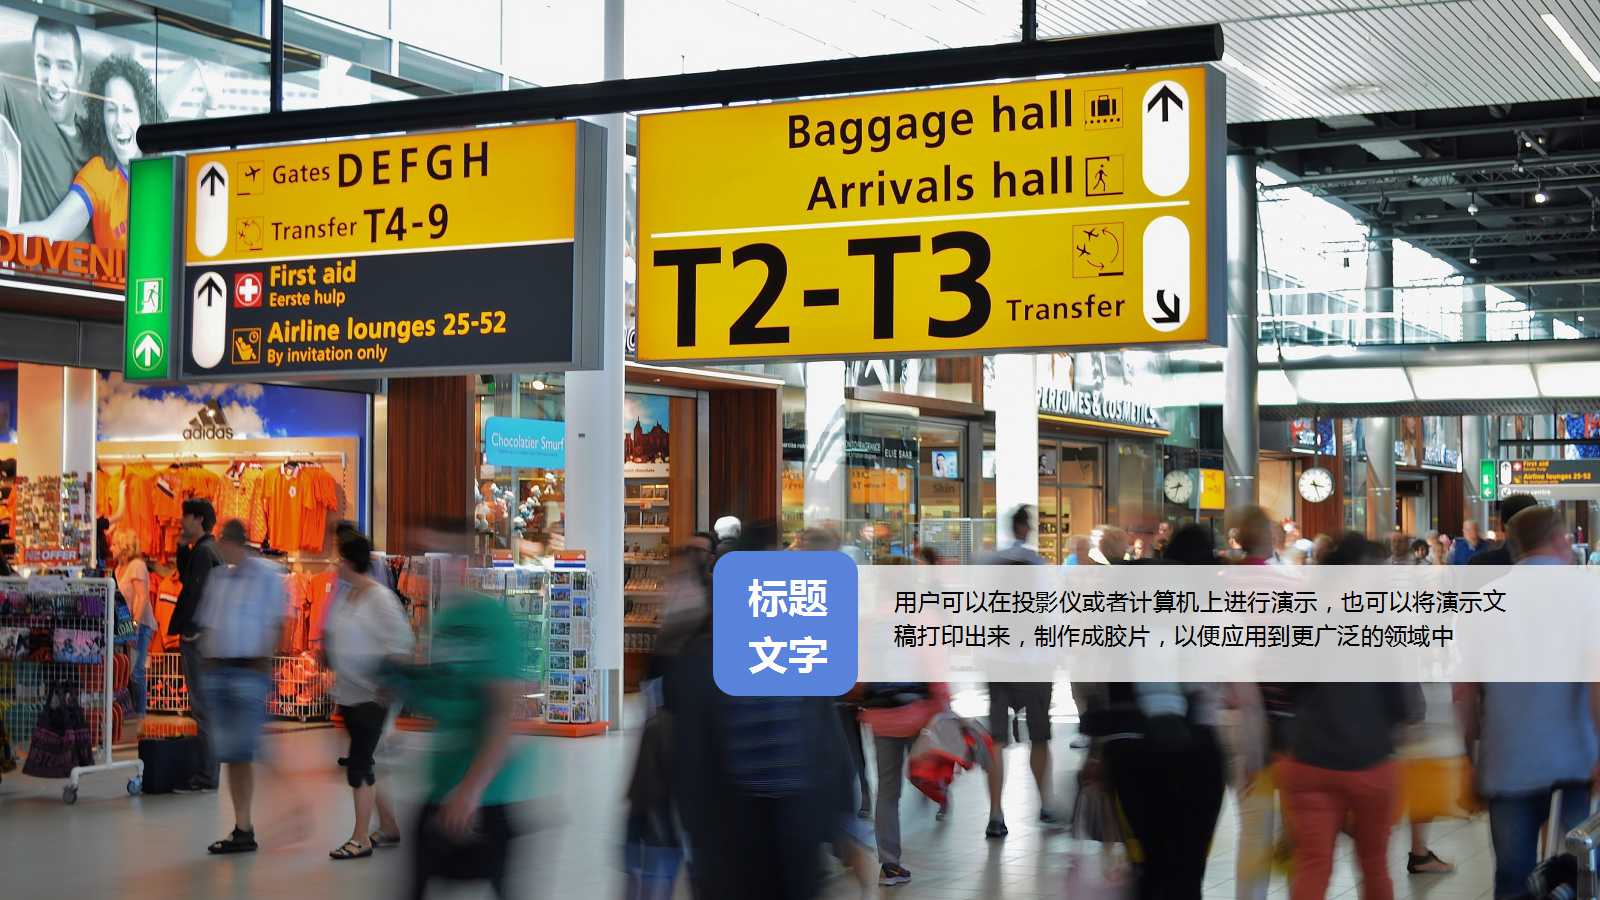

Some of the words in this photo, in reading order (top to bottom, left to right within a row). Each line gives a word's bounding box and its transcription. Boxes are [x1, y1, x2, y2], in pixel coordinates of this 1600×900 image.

[788, 108, 974, 155] Baggage
[993, 88, 1072, 133] hall
[272, 164, 331, 186] Gates
[806, 164, 974, 211] Arrivals
[993, 155, 1073, 199] hall
[272, 217, 358, 241] Transfer
[364, 203, 449, 243] T4-9
[269, 263, 318, 287] First
[321, 258, 358, 284] aid
[269, 291, 312, 308] Eerste
[314, 288, 346, 308] hulp
[653, 230, 993, 349] T2-T3
[1006, 294, 1126, 322] Transfer
[267, 318, 341, 343] Airline
[346, 315, 436, 346] lounges
[442, 309, 508, 336] 25-52
[267, 349, 284, 367] By
[287, 345, 354, 364] invitation
[356, 344, 389, 364] only
[1036, 386, 1091, 414] PERFUMES
[1092, 390, 1102, 417] &
[1103, 399, 1156, 424] COSMETICS
[182, 425, 234, 440] adidas
[491, 431, 538, 449] Chocolatier
